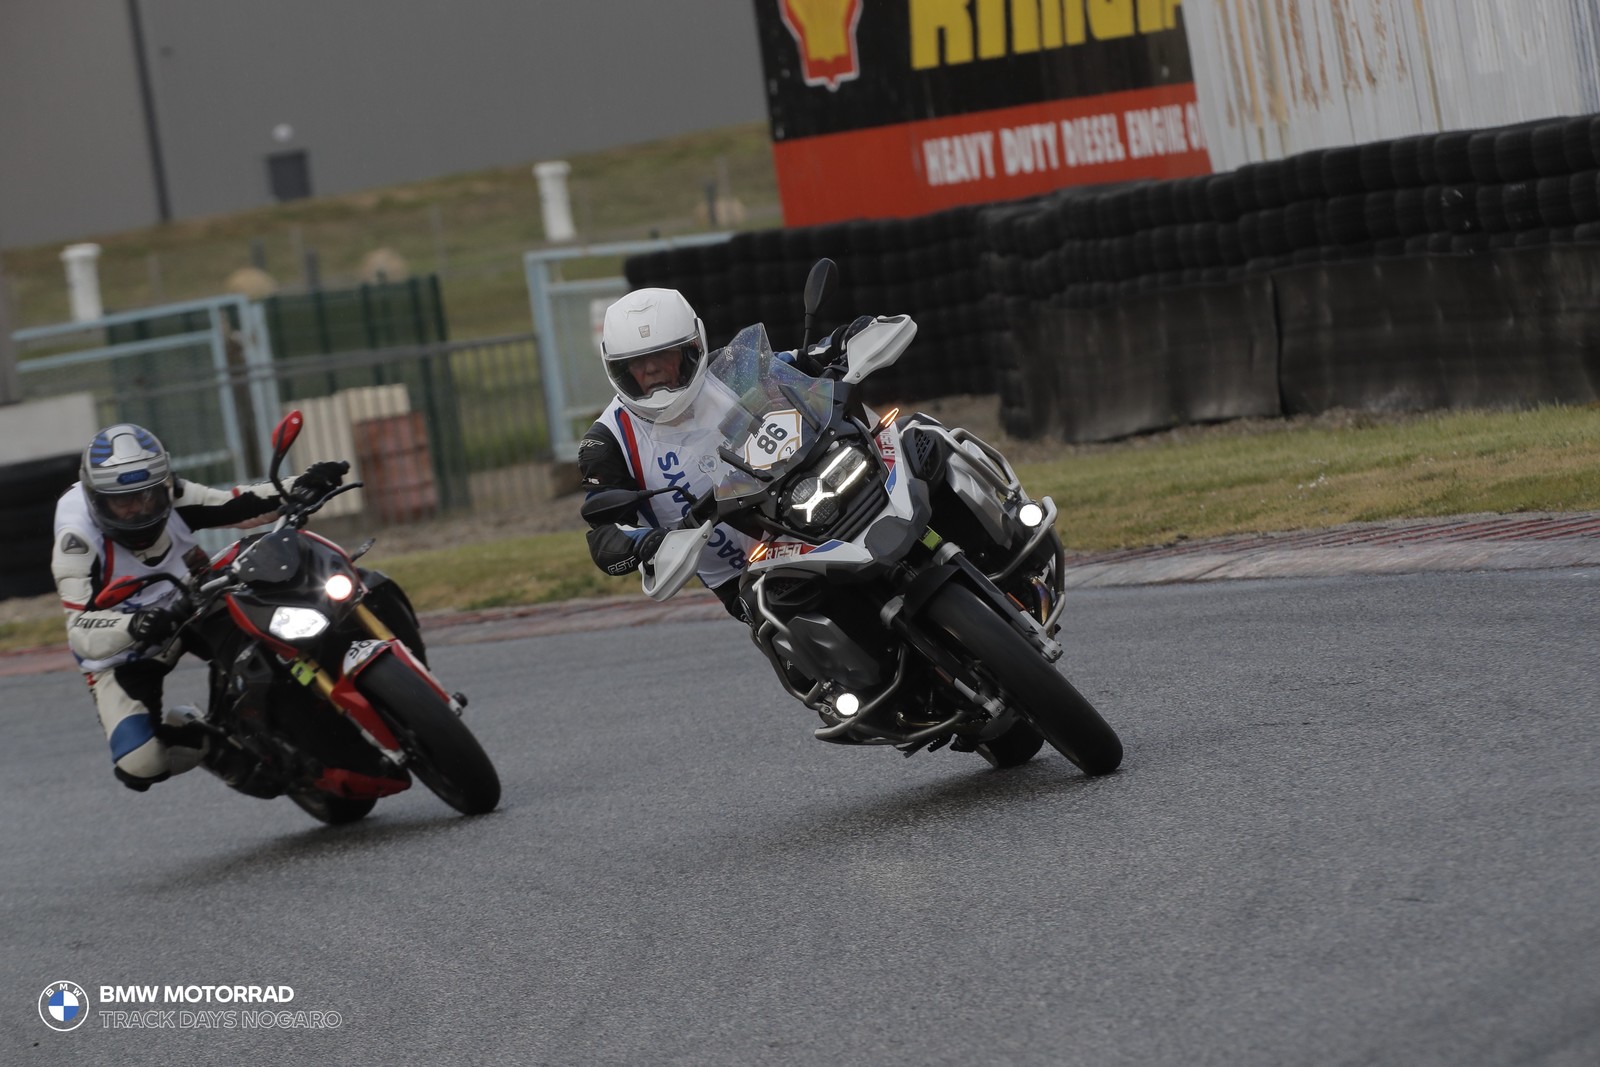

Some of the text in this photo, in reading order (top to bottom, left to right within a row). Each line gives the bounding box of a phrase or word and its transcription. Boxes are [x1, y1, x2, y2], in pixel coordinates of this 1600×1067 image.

[923, 131, 996, 187] HEAVY
[999, 121, 1059, 176] DUTY
[1060, 113, 1126, 168] DIESEL
[1124, 104, 1187, 160] ENGINE
[757, 423, 788, 455] 86
[785, 446, 795, 455] 2
